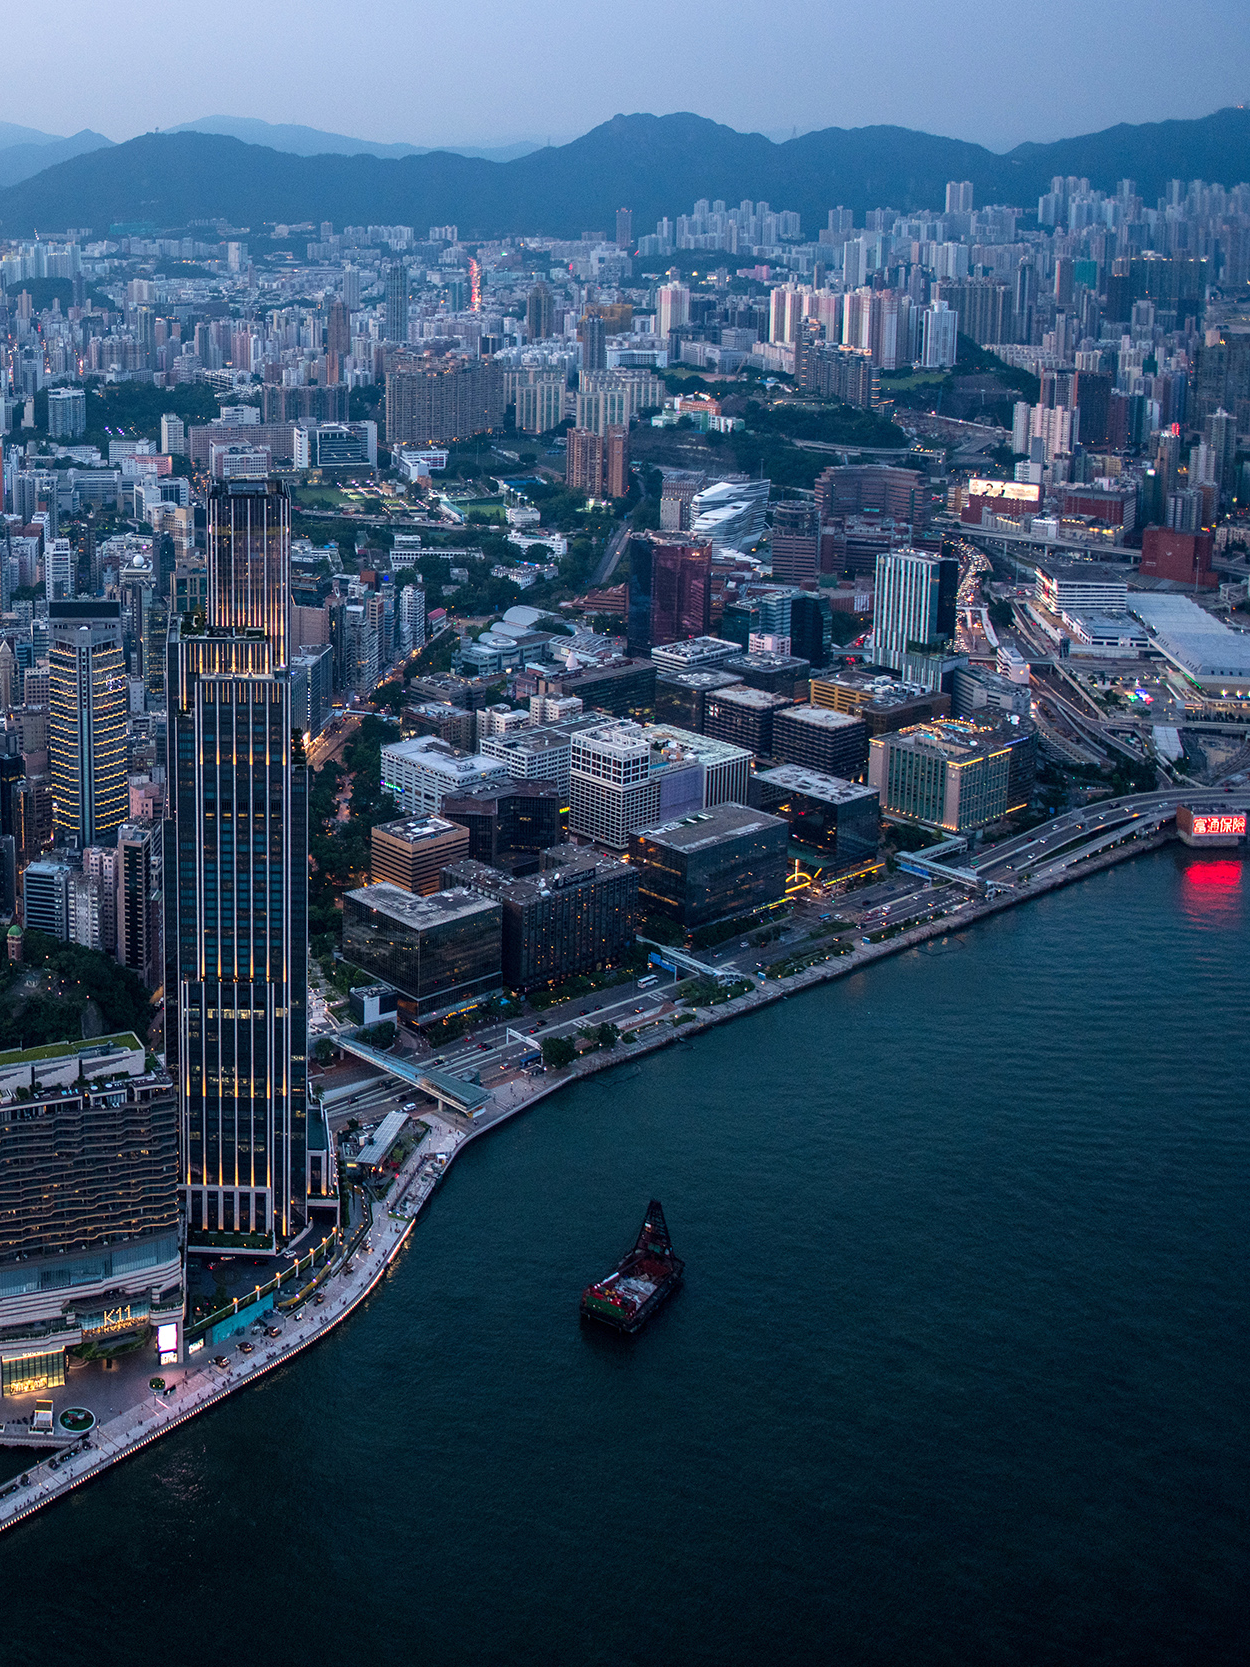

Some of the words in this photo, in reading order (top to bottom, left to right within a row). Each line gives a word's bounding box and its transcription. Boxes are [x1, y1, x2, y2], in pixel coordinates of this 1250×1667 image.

[1193, 815, 1246, 834] 富通保險
[103, 1304, 132, 1326] K11
